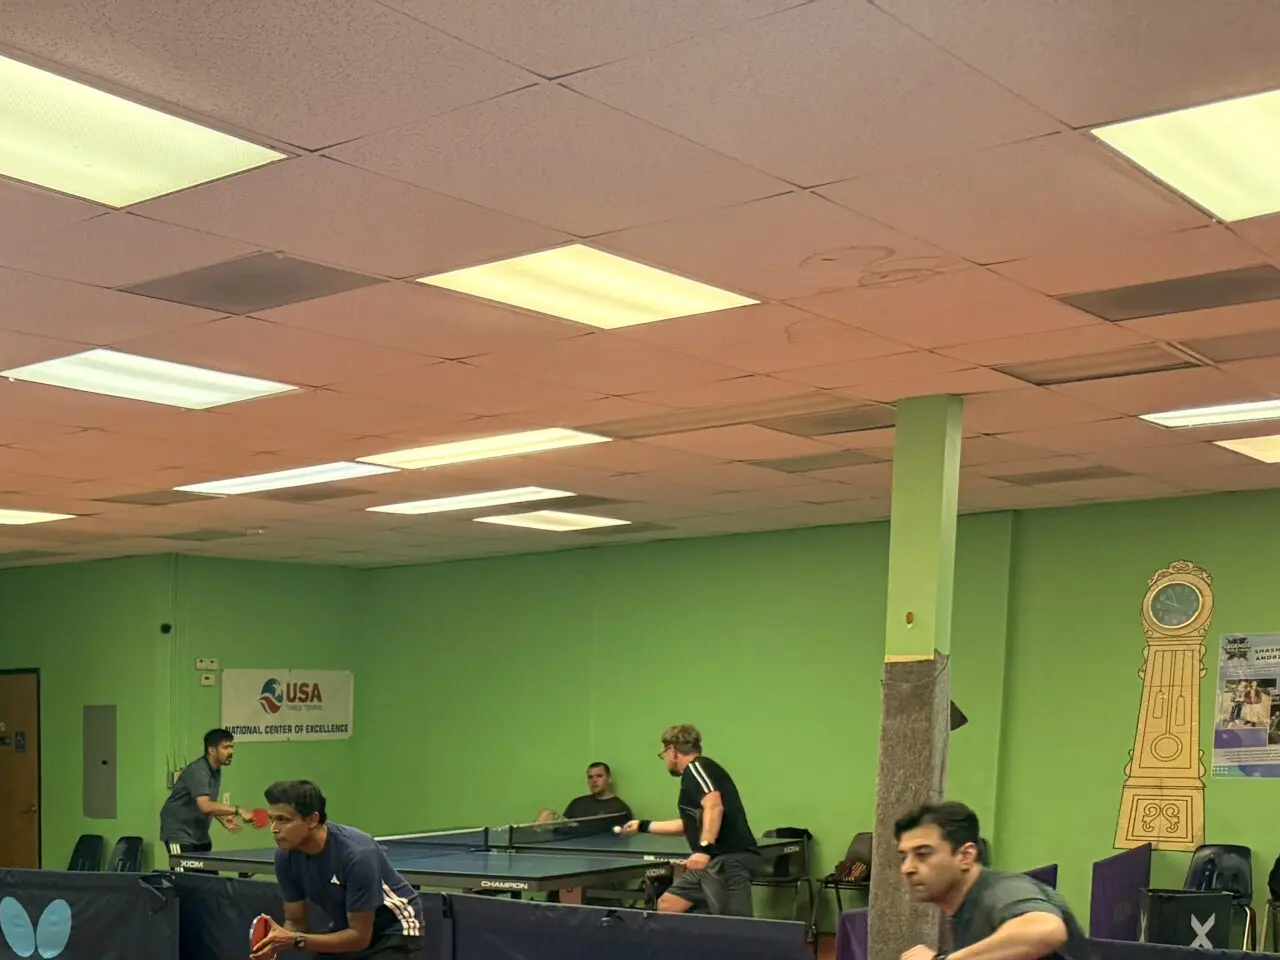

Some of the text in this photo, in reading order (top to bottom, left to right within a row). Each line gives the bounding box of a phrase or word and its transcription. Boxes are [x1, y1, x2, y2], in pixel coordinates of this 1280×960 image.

[286, 682, 322, 703] USA
[264, 725, 292, 734] CENTER
[294, 725, 303, 734] OF
[306, 724, 348, 733] EXCELLENCE
[180, 860, 204, 868] XIOM
[481, 880, 528, 890] CHAMPION
